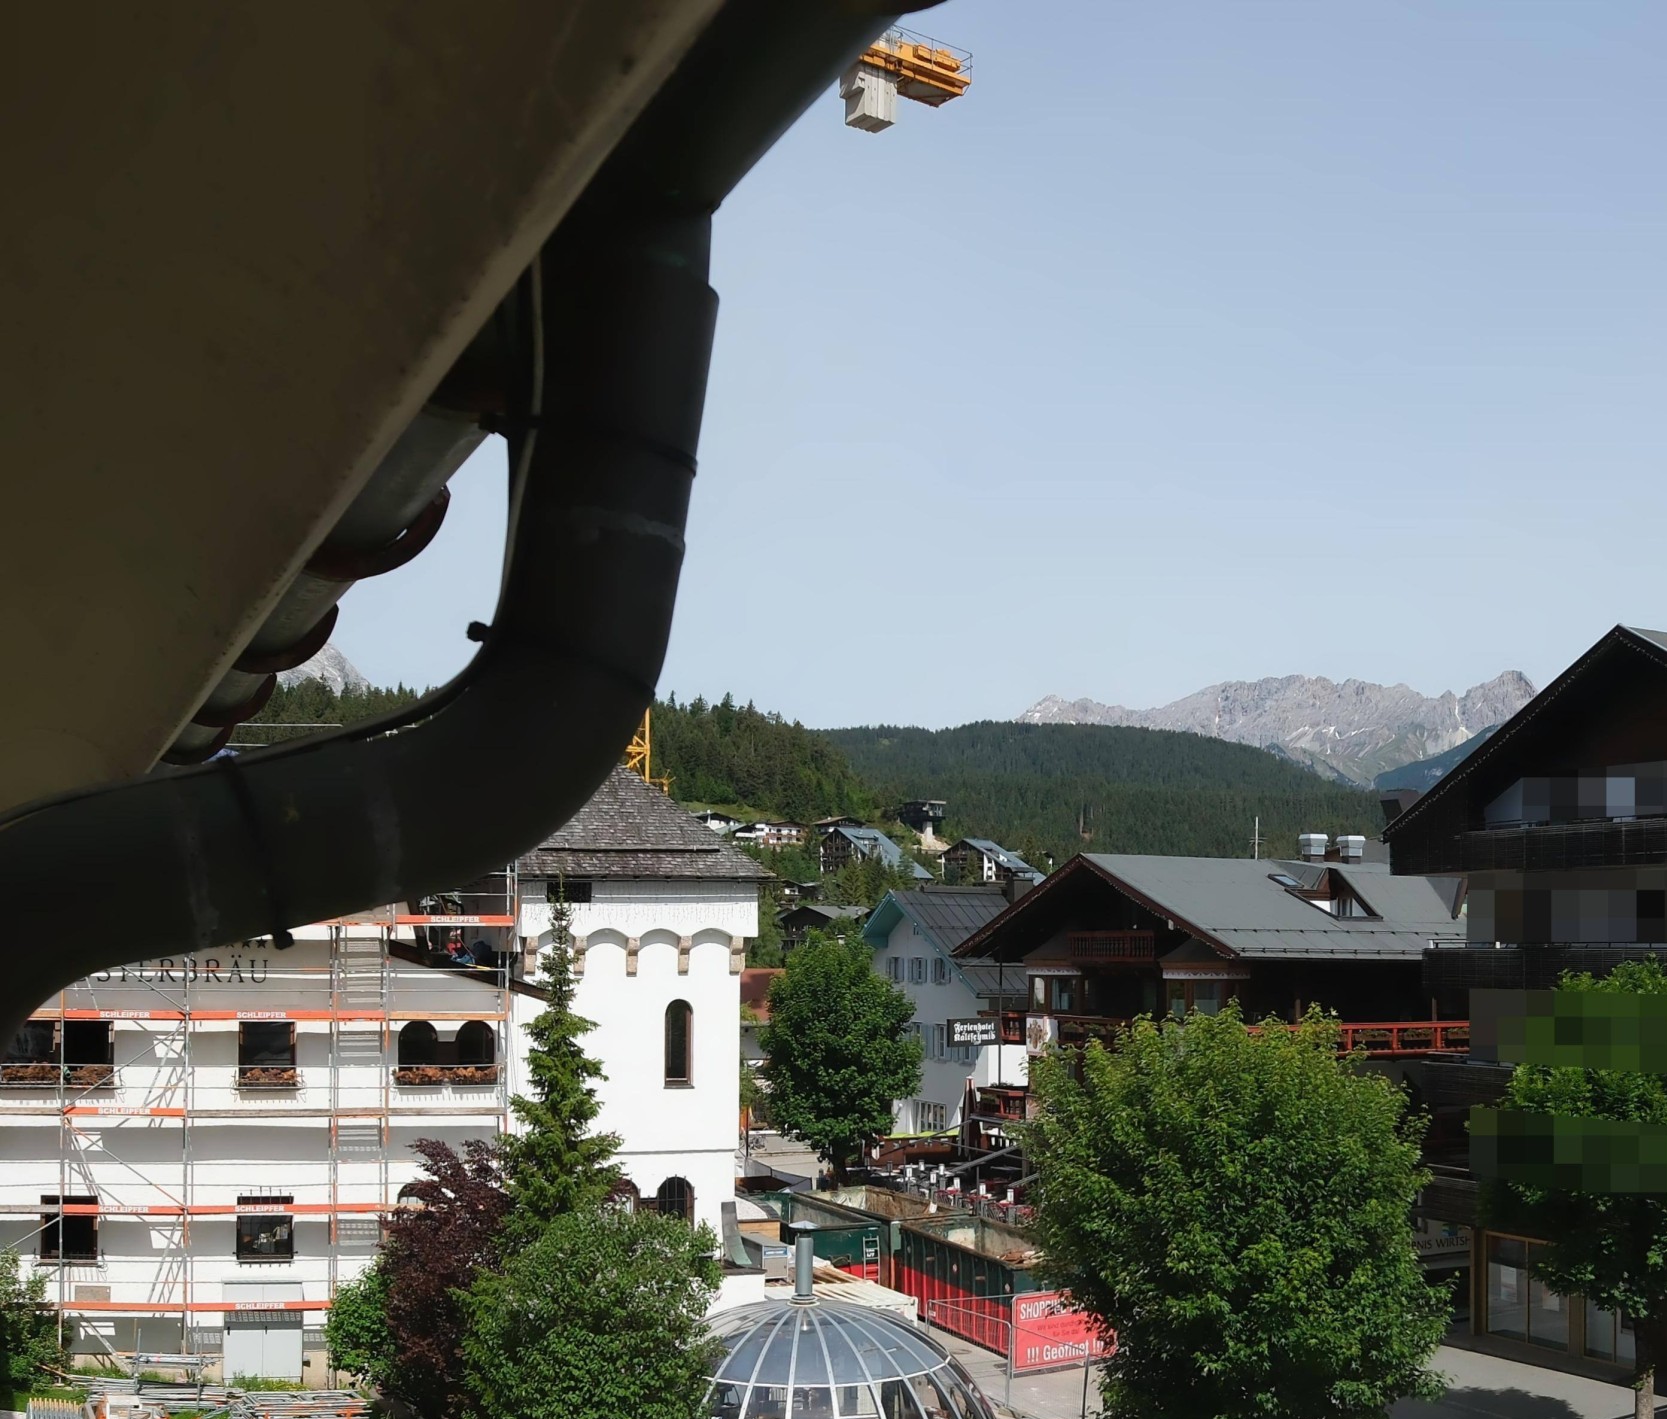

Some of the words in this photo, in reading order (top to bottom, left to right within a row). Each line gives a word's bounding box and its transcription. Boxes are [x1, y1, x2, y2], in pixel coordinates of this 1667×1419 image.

[430, 915, 480, 923] SCHLEIPFER
[78, 954, 269, 984] STERBRÄU
[97, 1107, 151, 1115] SCHLEIPFER
[98, 1205, 149, 1213] SCHLEIPFER
[234, 1205, 285, 1213] SCHLEIPFER
[235, 1302, 286, 1310] SCHLEIPFER
[1043, 1340, 1090, 1361] Geöffnet
